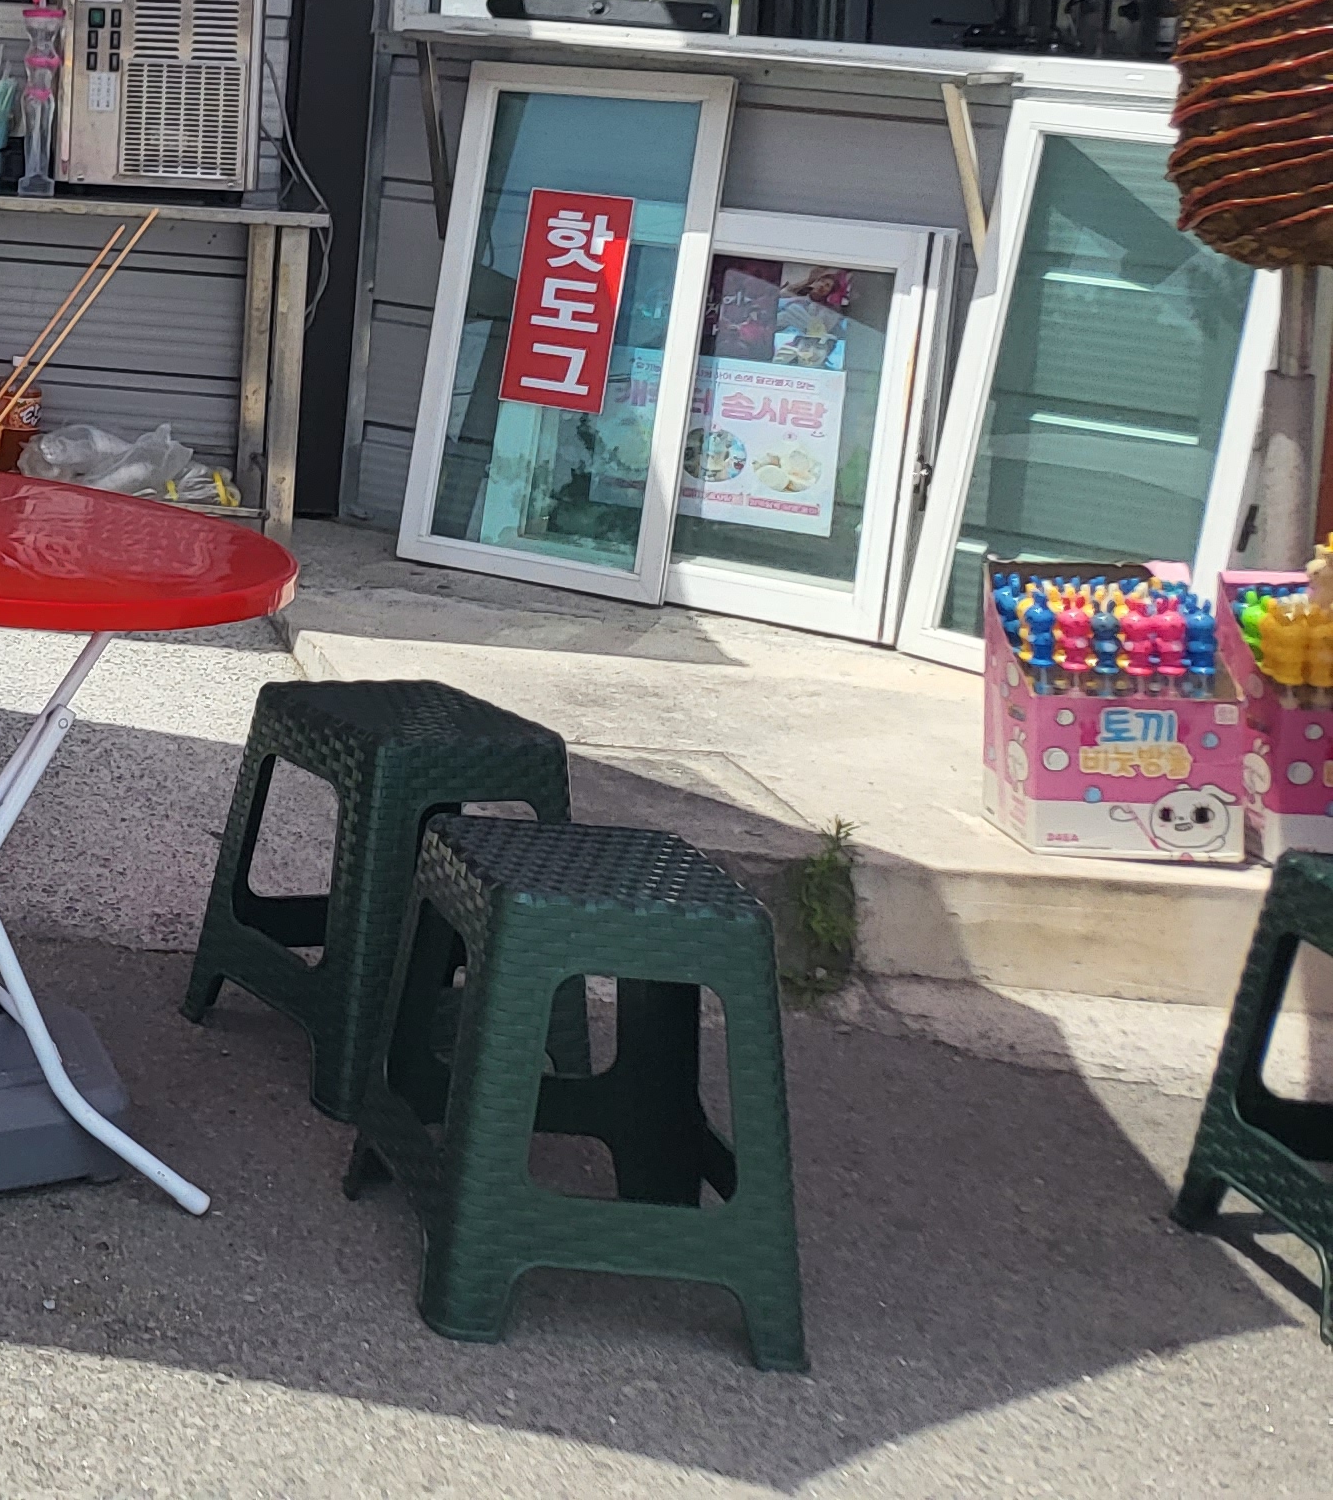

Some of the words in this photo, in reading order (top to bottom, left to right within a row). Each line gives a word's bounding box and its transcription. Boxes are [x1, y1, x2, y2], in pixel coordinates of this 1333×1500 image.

[520, 209, 614, 396] 핫도그
[721, 391, 829, 430] 솜사탕
[1101, 708, 1177, 743] 토끼
[1081, 747, 1192, 779] 비눗방울
